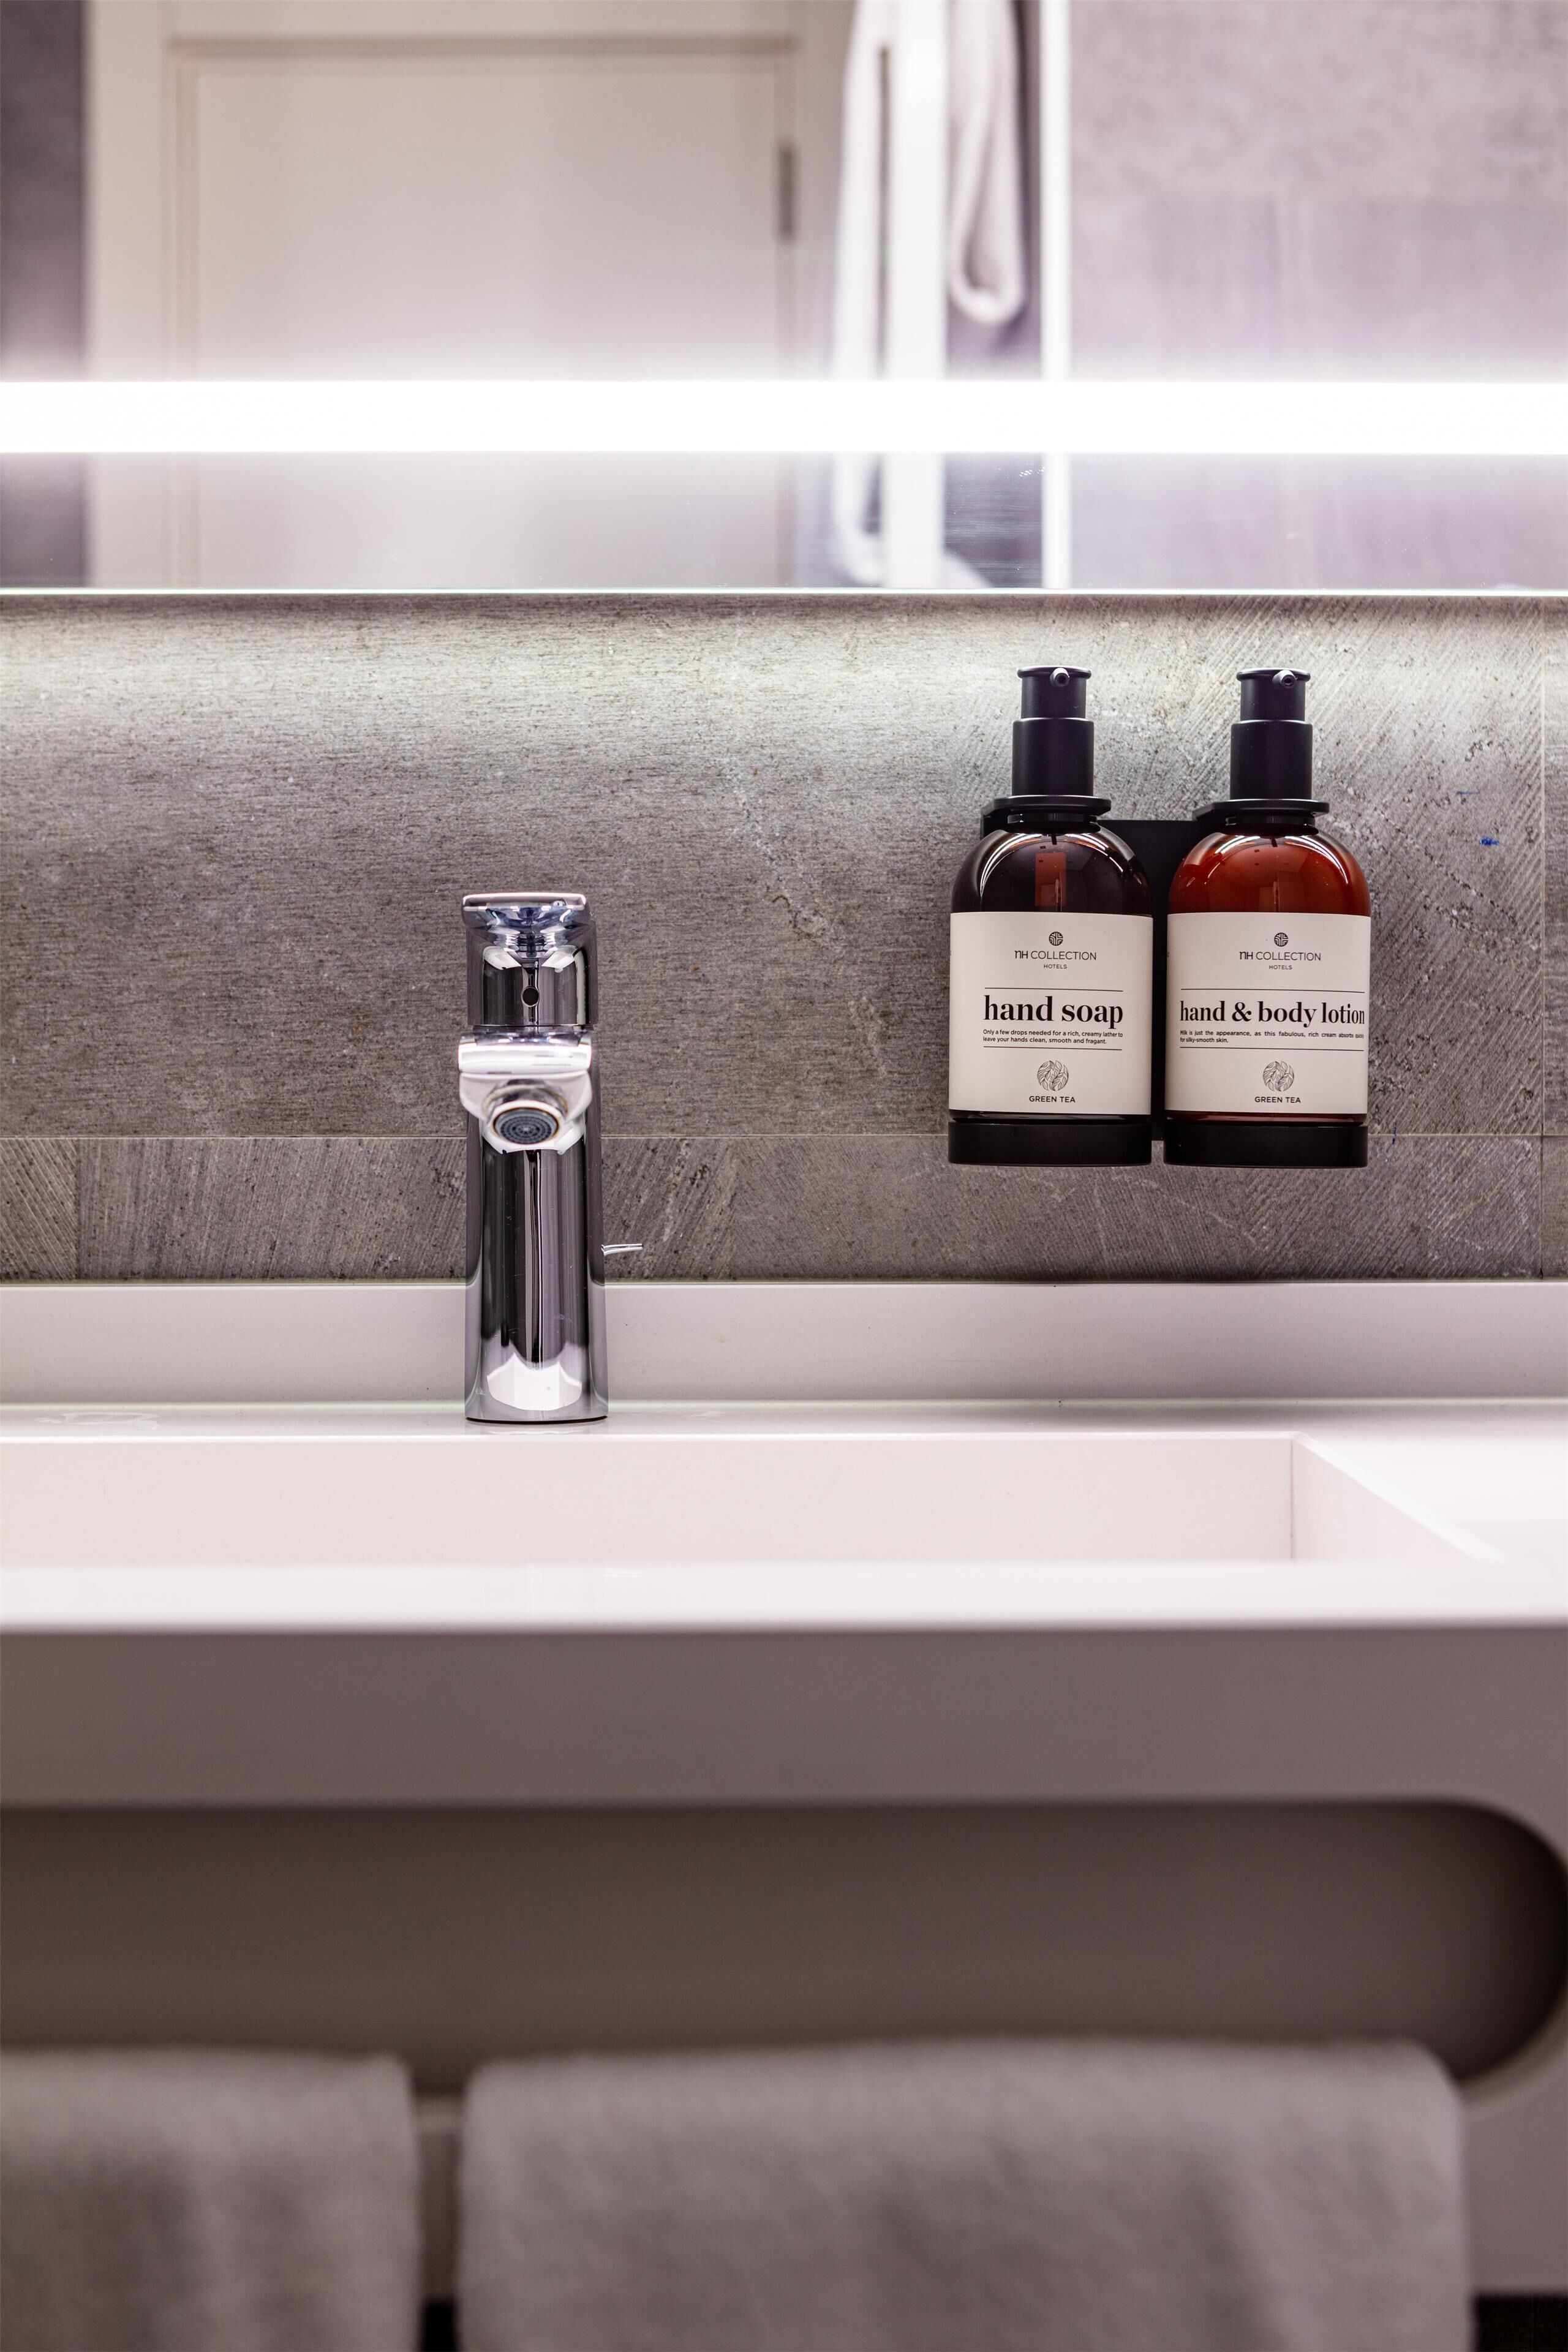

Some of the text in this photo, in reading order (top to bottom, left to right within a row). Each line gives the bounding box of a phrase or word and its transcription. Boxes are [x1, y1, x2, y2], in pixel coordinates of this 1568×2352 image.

[1031, 951, 1097, 961] COLLECTION
[1256, 951, 1321, 961] COLLECTION
[983, 995, 1123, 1030] hand soap
[1180, 1001, 1365, 1028] hand & body lotion
